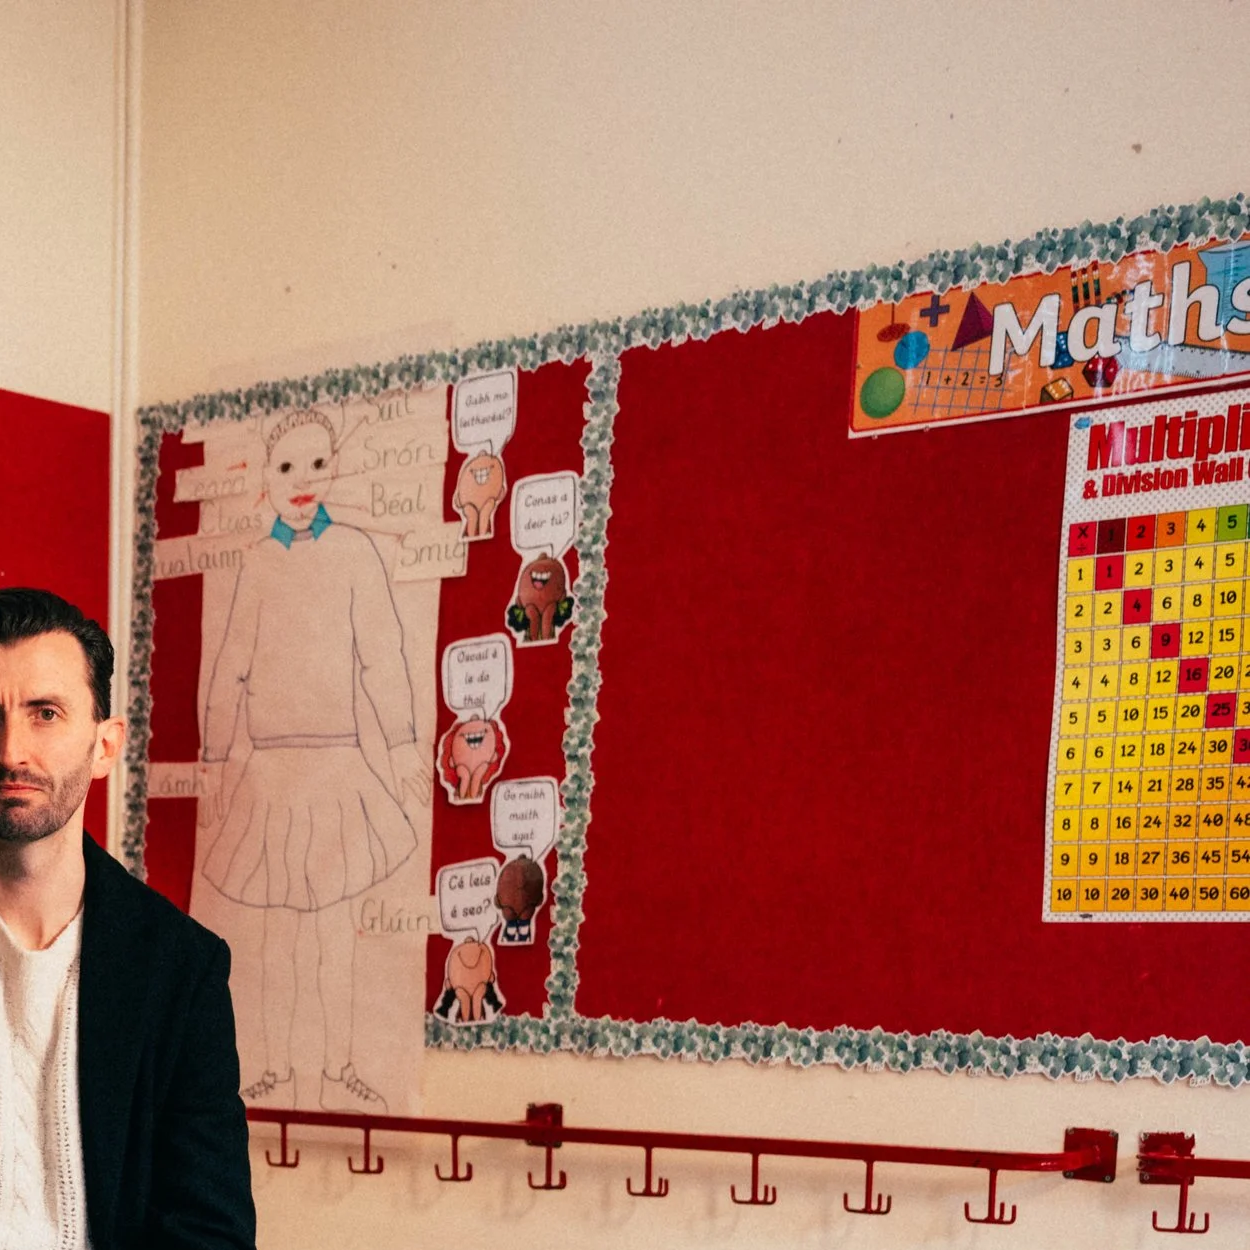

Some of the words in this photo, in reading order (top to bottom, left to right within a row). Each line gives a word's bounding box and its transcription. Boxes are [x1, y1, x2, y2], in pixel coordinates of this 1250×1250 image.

[989, 260, 1250, 377] Maths
[924, 371, 931, 386] 1
[959, 370, 970, 386] 2
[993, 373, 1004, 389] 3
[362, 435, 436, 471] Srón
[1082, 479, 1098, 500] &
[1101, 466, 1188, 498] Division
[1192, 456, 1245, 487] Wall
[370, 481, 427, 518] Béal
[524, 494, 558, 508] Conas
[199, 502, 263, 535] Cluas
[1136, 525, 1147, 540] 2
[1166, 522, 1176, 536] 3
[1196, 519, 1207, 533] 4
[1227, 514, 1238, 530] 5
[154, 541, 244, 579] ualainn
[400, 529, 467, 574] Smig
[1077, 567, 1083, 581] 1
[1106, 564, 1113, 578] 1
[1134, 562, 1144, 576] 2
[1164, 559, 1174, 573] 3
[1194, 556, 1205, 570] 4
[1225, 553, 1236, 567] 5
[1074, 604, 1084, 617] 2
[1103, 602, 1113, 615] 2
[1132, 598, 1142, 613] 4
[1162, 596, 1172, 610] 6
[1192, 593, 1203, 608] 8
[1219, 590, 1238, 605] 10
[1073, 640, 1083, 653] 3
[1102, 638, 1112, 651] 3
[1131, 635, 1141, 649] 6
[1161, 632, 1171, 647] 9
[1188, 630, 1205, 645] 12
[1218, 628, 1236, 643] 15
[1071, 676, 1081, 689] 4
[1100, 674, 1110, 688] 4
[1129, 672, 1139, 686] 8
[1155, 670, 1172, 683] 12
[1186, 667, 1202, 681] 16
[1214, 665, 1235, 679] 20
[1068, 711, 1078, 725] 5
[1097, 709, 1107, 723] 5
[1123, 707, 1140, 722] 10
[1152, 706, 1169, 720] 15
[1180, 704, 1201, 718] 20
[1211, 702, 1232, 717] 25
[1065, 747, 1075, 760] 6
[1094, 746, 1104, 759] 6
[1120, 744, 1137, 758] 12
[1149, 743, 1166, 757] 18
[1177, 741, 1198, 755] 24
[1207, 739, 1228, 754] 30
[503, 789, 517, 802] Go
[518, 787, 546, 801] raibh
[1063, 782, 1074, 796] 7
[1092, 781, 1102, 794] 7
[1117, 779, 1134, 794] 14
[1146, 778, 1163, 792] 21
[1175, 777, 1195, 791] 28
[1205, 776, 1226, 790] 35
[508, 807, 540, 821] maith
[1061, 818, 1071, 831] 8
[1090, 817, 1100, 830] 8
[1115, 815, 1132, 829] 16
[1142, 815, 1162, 829] 24
[1173, 814, 1193, 828] 32
[1202, 813, 1224, 827] 40
[1060, 853, 1070, 866] 9
[1088, 852, 1099, 865] 9
[1114, 851, 1130, 865] 18
[1141, 850, 1161, 865] 27
[1171, 850, 1191, 864] 36
[1201, 849, 1222, 863] 45
[1056, 887, 1073, 901] 10
[1084, 887, 1101, 901] 10
[1111, 887, 1131, 901] 20
[1139, 887, 1160, 901] 30
[1168, 887, 1190, 901] 40
[1199, 887, 1220, 901] 50
[1229, 887, 1250, 901] 60
[360, 898, 434, 934] Glúin
[461, 897, 492, 919] seo?
